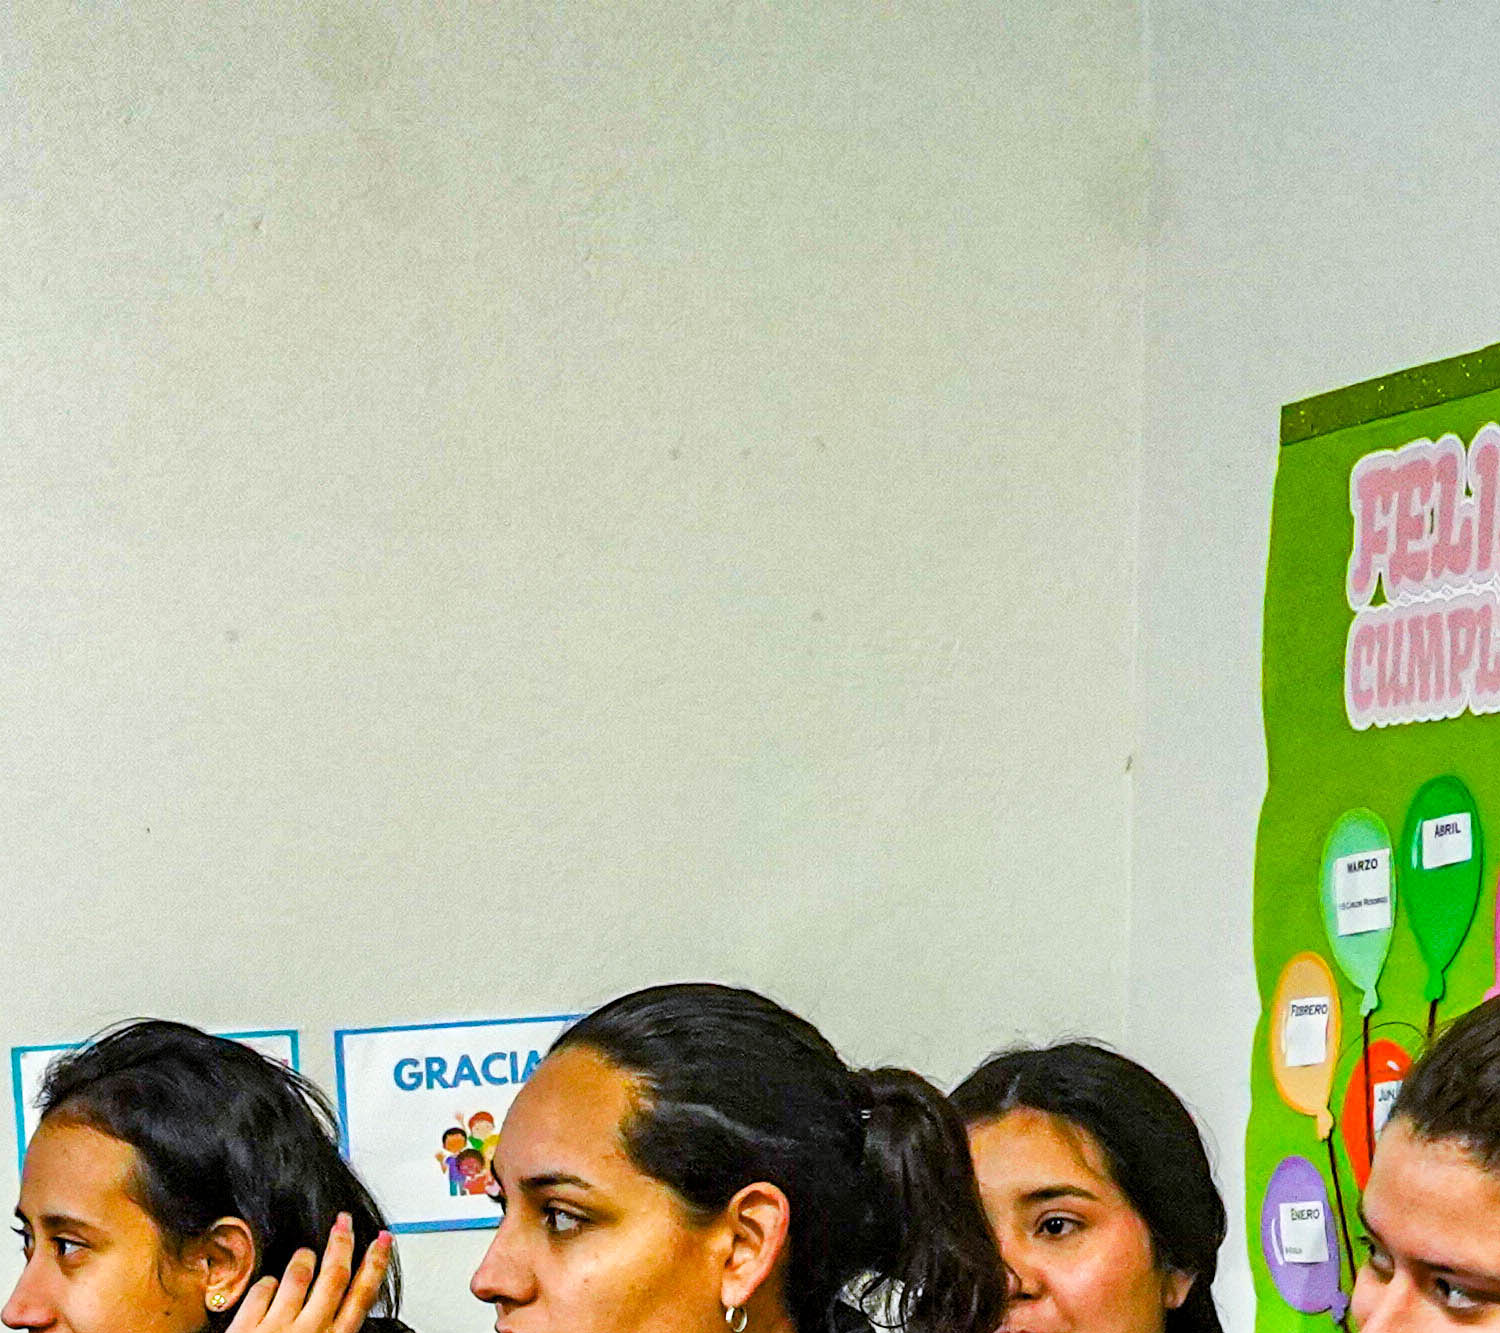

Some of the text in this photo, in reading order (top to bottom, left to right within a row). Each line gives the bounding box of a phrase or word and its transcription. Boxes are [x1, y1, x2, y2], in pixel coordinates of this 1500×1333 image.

[1433, 821, 1462, 840] ABRIL
[1346, 858, 1378, 873] MARZO
[393, 1050, 541, 1091] GRACIA
[1290, 1208, 1320, 1221] ENERO
